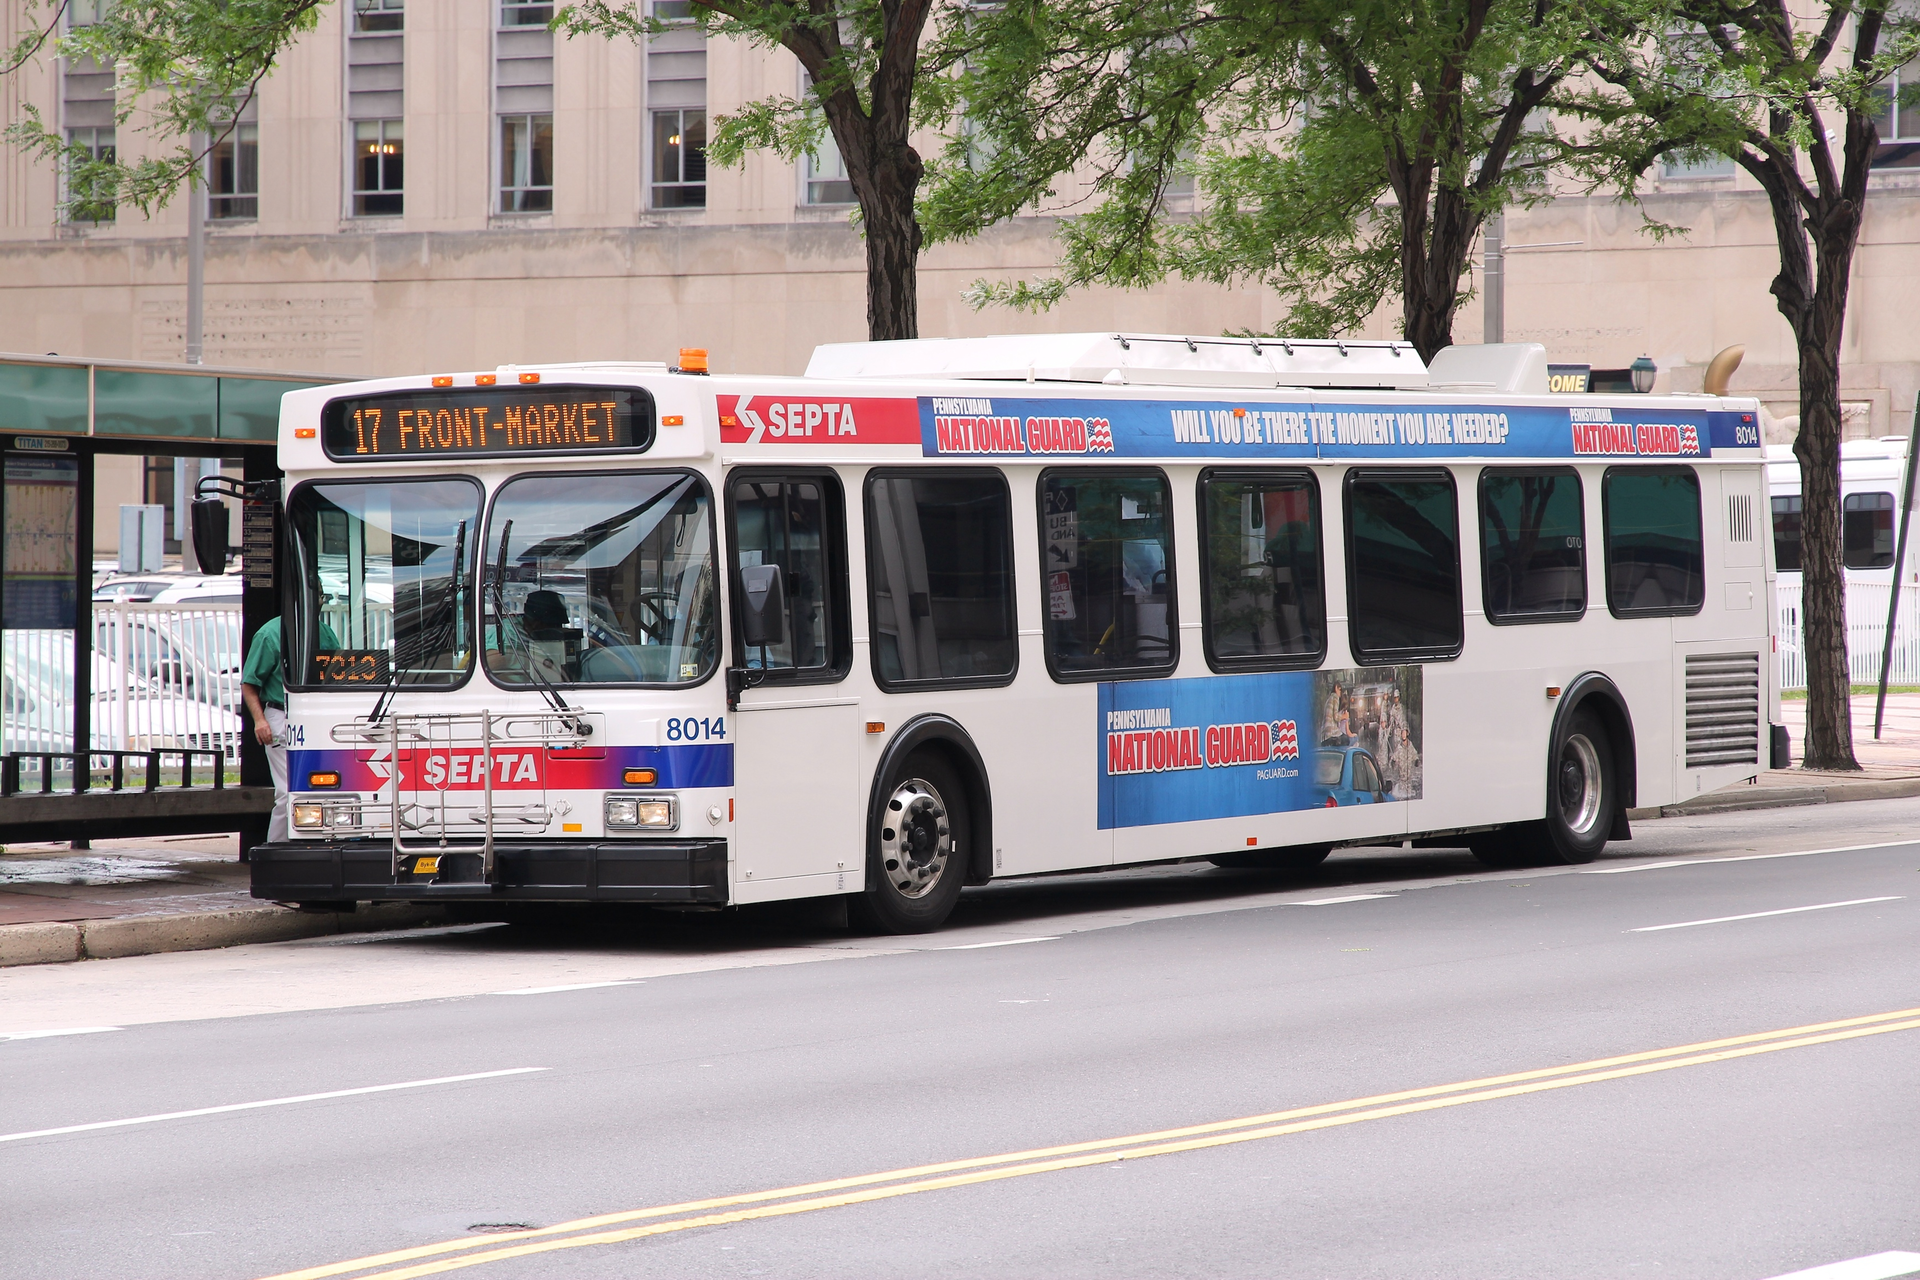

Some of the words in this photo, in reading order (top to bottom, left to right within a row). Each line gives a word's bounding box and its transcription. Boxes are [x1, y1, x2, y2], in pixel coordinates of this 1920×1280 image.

[932, 398, 993, 415] PENNSYLVANIA
[1569, 408, 1613, 422] PENNSYLVANIA
[353, 408, 382, 453] 17
[398, 402, 617, 449] FRONT-MARKET
[768, 403, 857, 437] SEPTA
[1170, 410, 1211, 443] WILL
[1209, 410, 1241, 444] YOU
[1242, 411, 1263, 444] BE
[1262, 411, 1309, 444] THERE
[1308, 412, 1337, 444] THE
[1336, 412, 1396, 445] MOMENT
[1396, 412, 1425, 445] YOU
[1426, 413, 1452, 444] ARE
[1452, 413, 1509, 444] NEEDED?
[18, 438, 43, 448] TITAN
[935, 416, 1026, 454] NATIONAL
[1026, 416, 1088, 454] GUARD
[1571, 422, 1636, 455] NATIONAL
[1636, 424, 1681, 455] GUARD
[1735, 426, 1757, 445] 8014
[667, 717, 726, 741] 8014
[1107, 708, 1171, 730] PENNSYLVANIA
[285, 724, 305, 746] 014
[1107, 726, 1203, 776] NATIONAL
[1205, 721, 1271, 768] GUARD
[423, 753, 538, 785] SEPTA
[1257, 768, 1299, 780] PAGUARD.com
